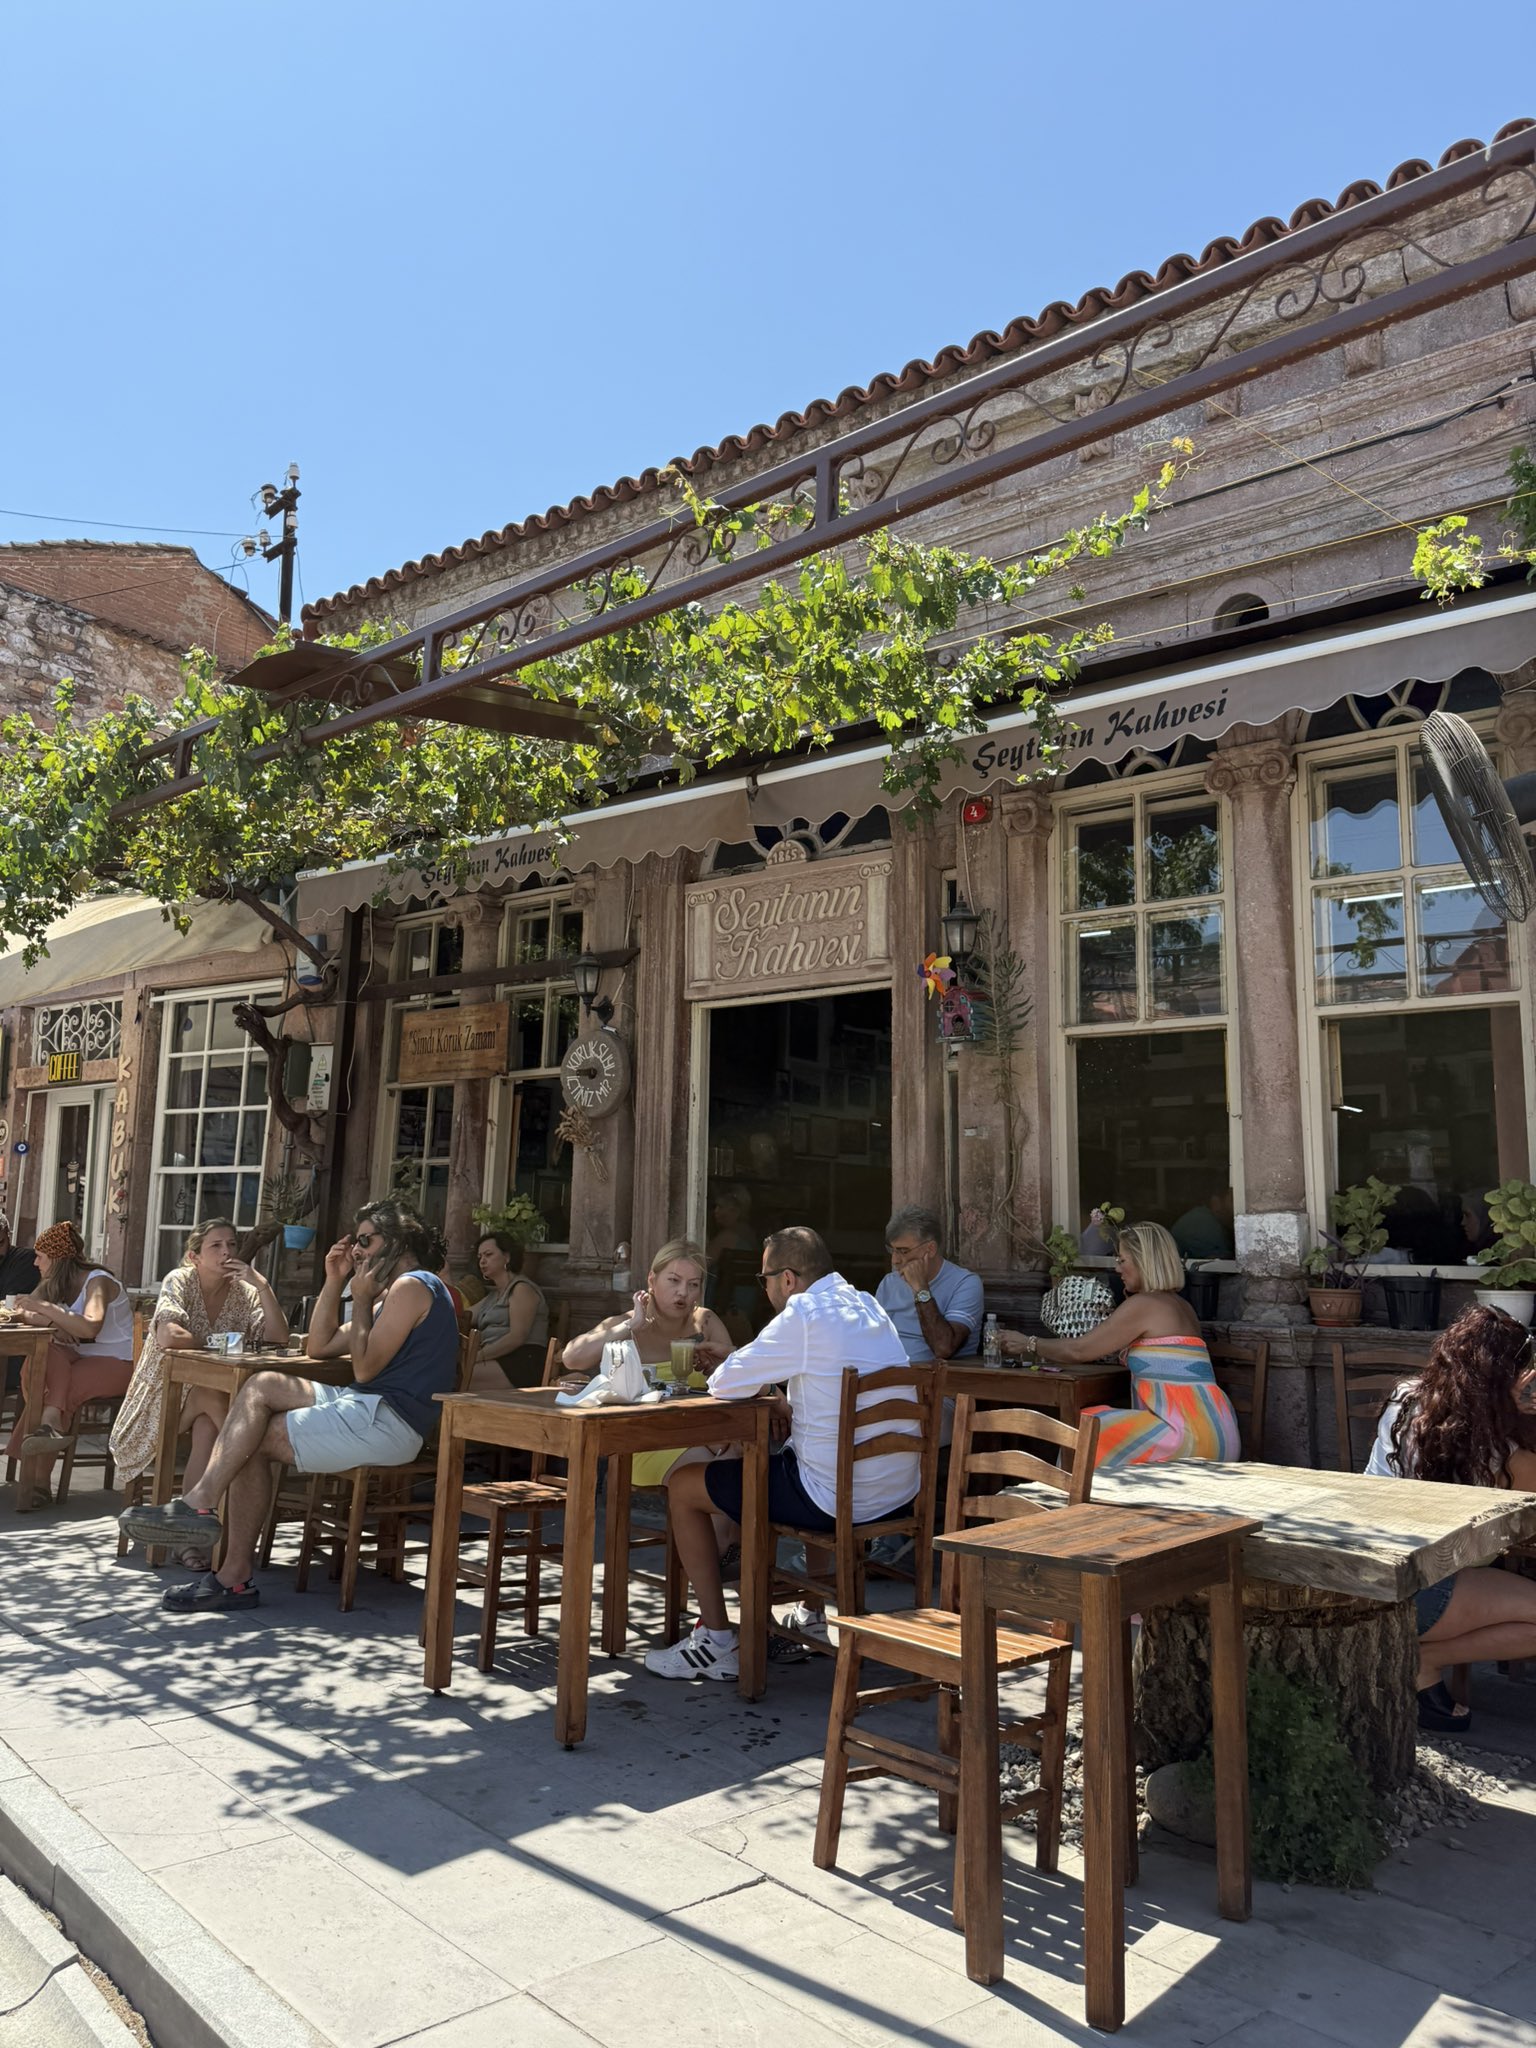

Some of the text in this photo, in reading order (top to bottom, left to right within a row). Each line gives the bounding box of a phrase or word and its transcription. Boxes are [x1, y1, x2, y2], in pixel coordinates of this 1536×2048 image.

[1103, 687, 1229, 746] Kahvesi
[969, 805, 978, 818] 4
[494, 842, 555, 874] Kahves
[772, 848, 798, 864] 1865
[714, 920, 864, 981] Kahvesi
[436, 1025, 463, 1054] Koruk
[48, 1051, 80, 1082] COFFEE
[566, 1040, 600, 1071] KORUK
[108, 1054, 132, 1215] KABUK
